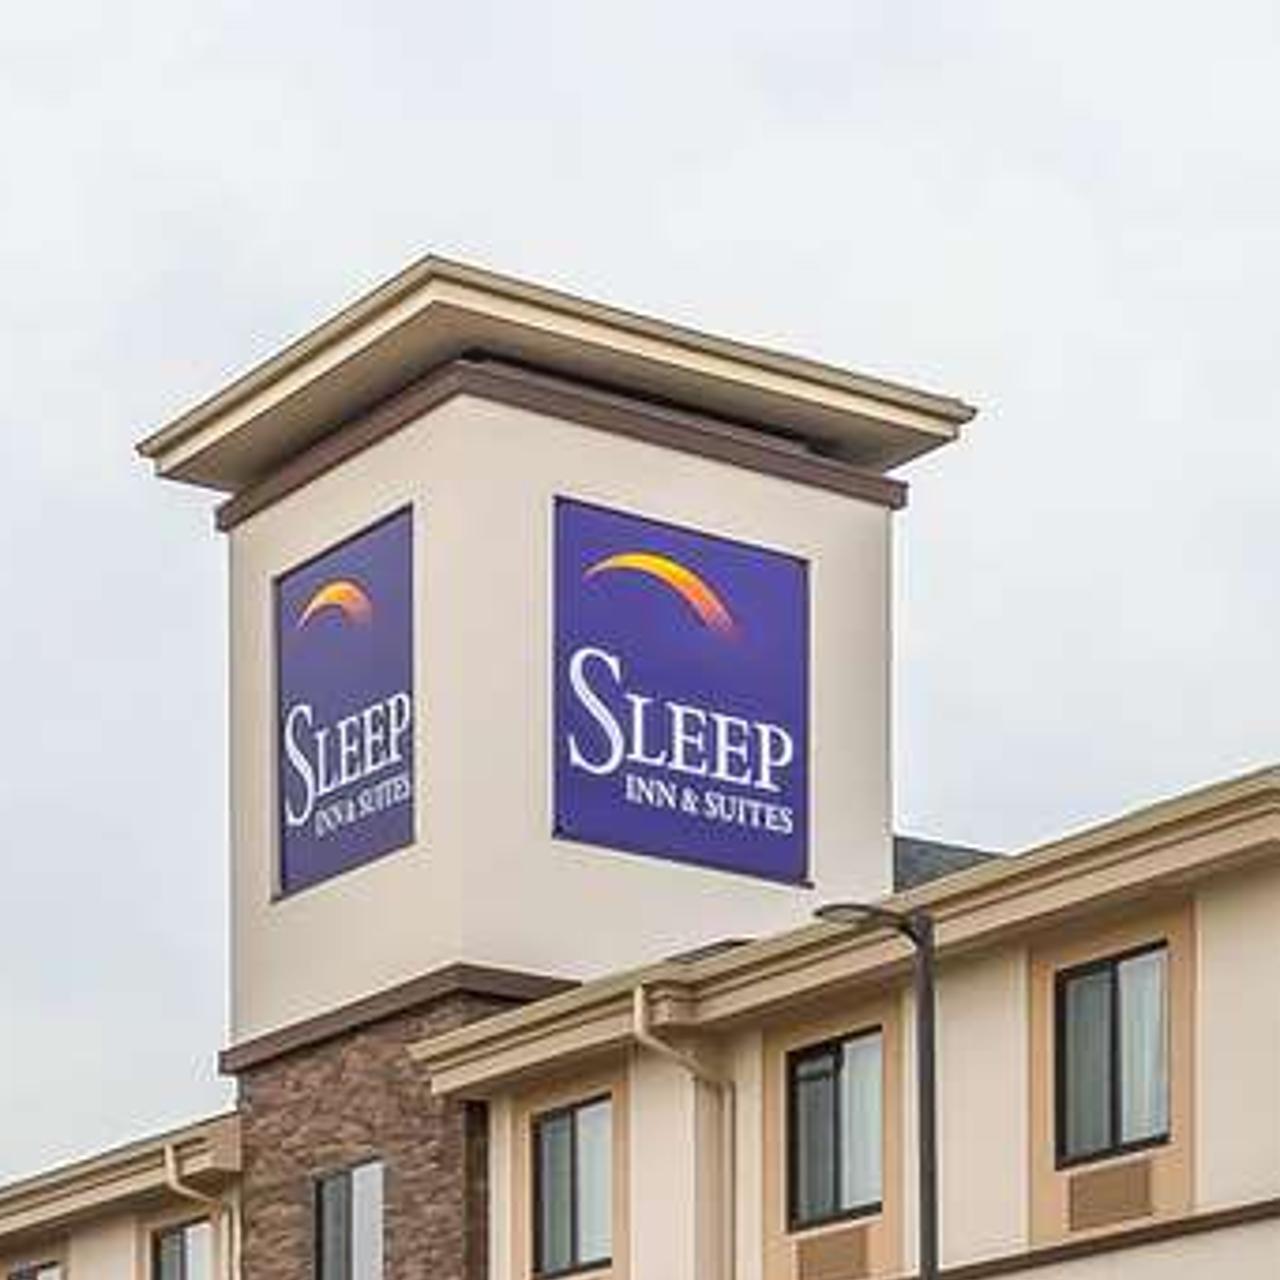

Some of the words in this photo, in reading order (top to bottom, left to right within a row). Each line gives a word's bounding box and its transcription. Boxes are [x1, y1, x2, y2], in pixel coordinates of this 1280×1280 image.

[284, 692, 411, 826] SLEEP
[569, 648, 794, 792] SLEEP
[625, 774, 677, 808] INN
[679, 787, 700, 815] &
[704, 790, 794, 834] SUITES
